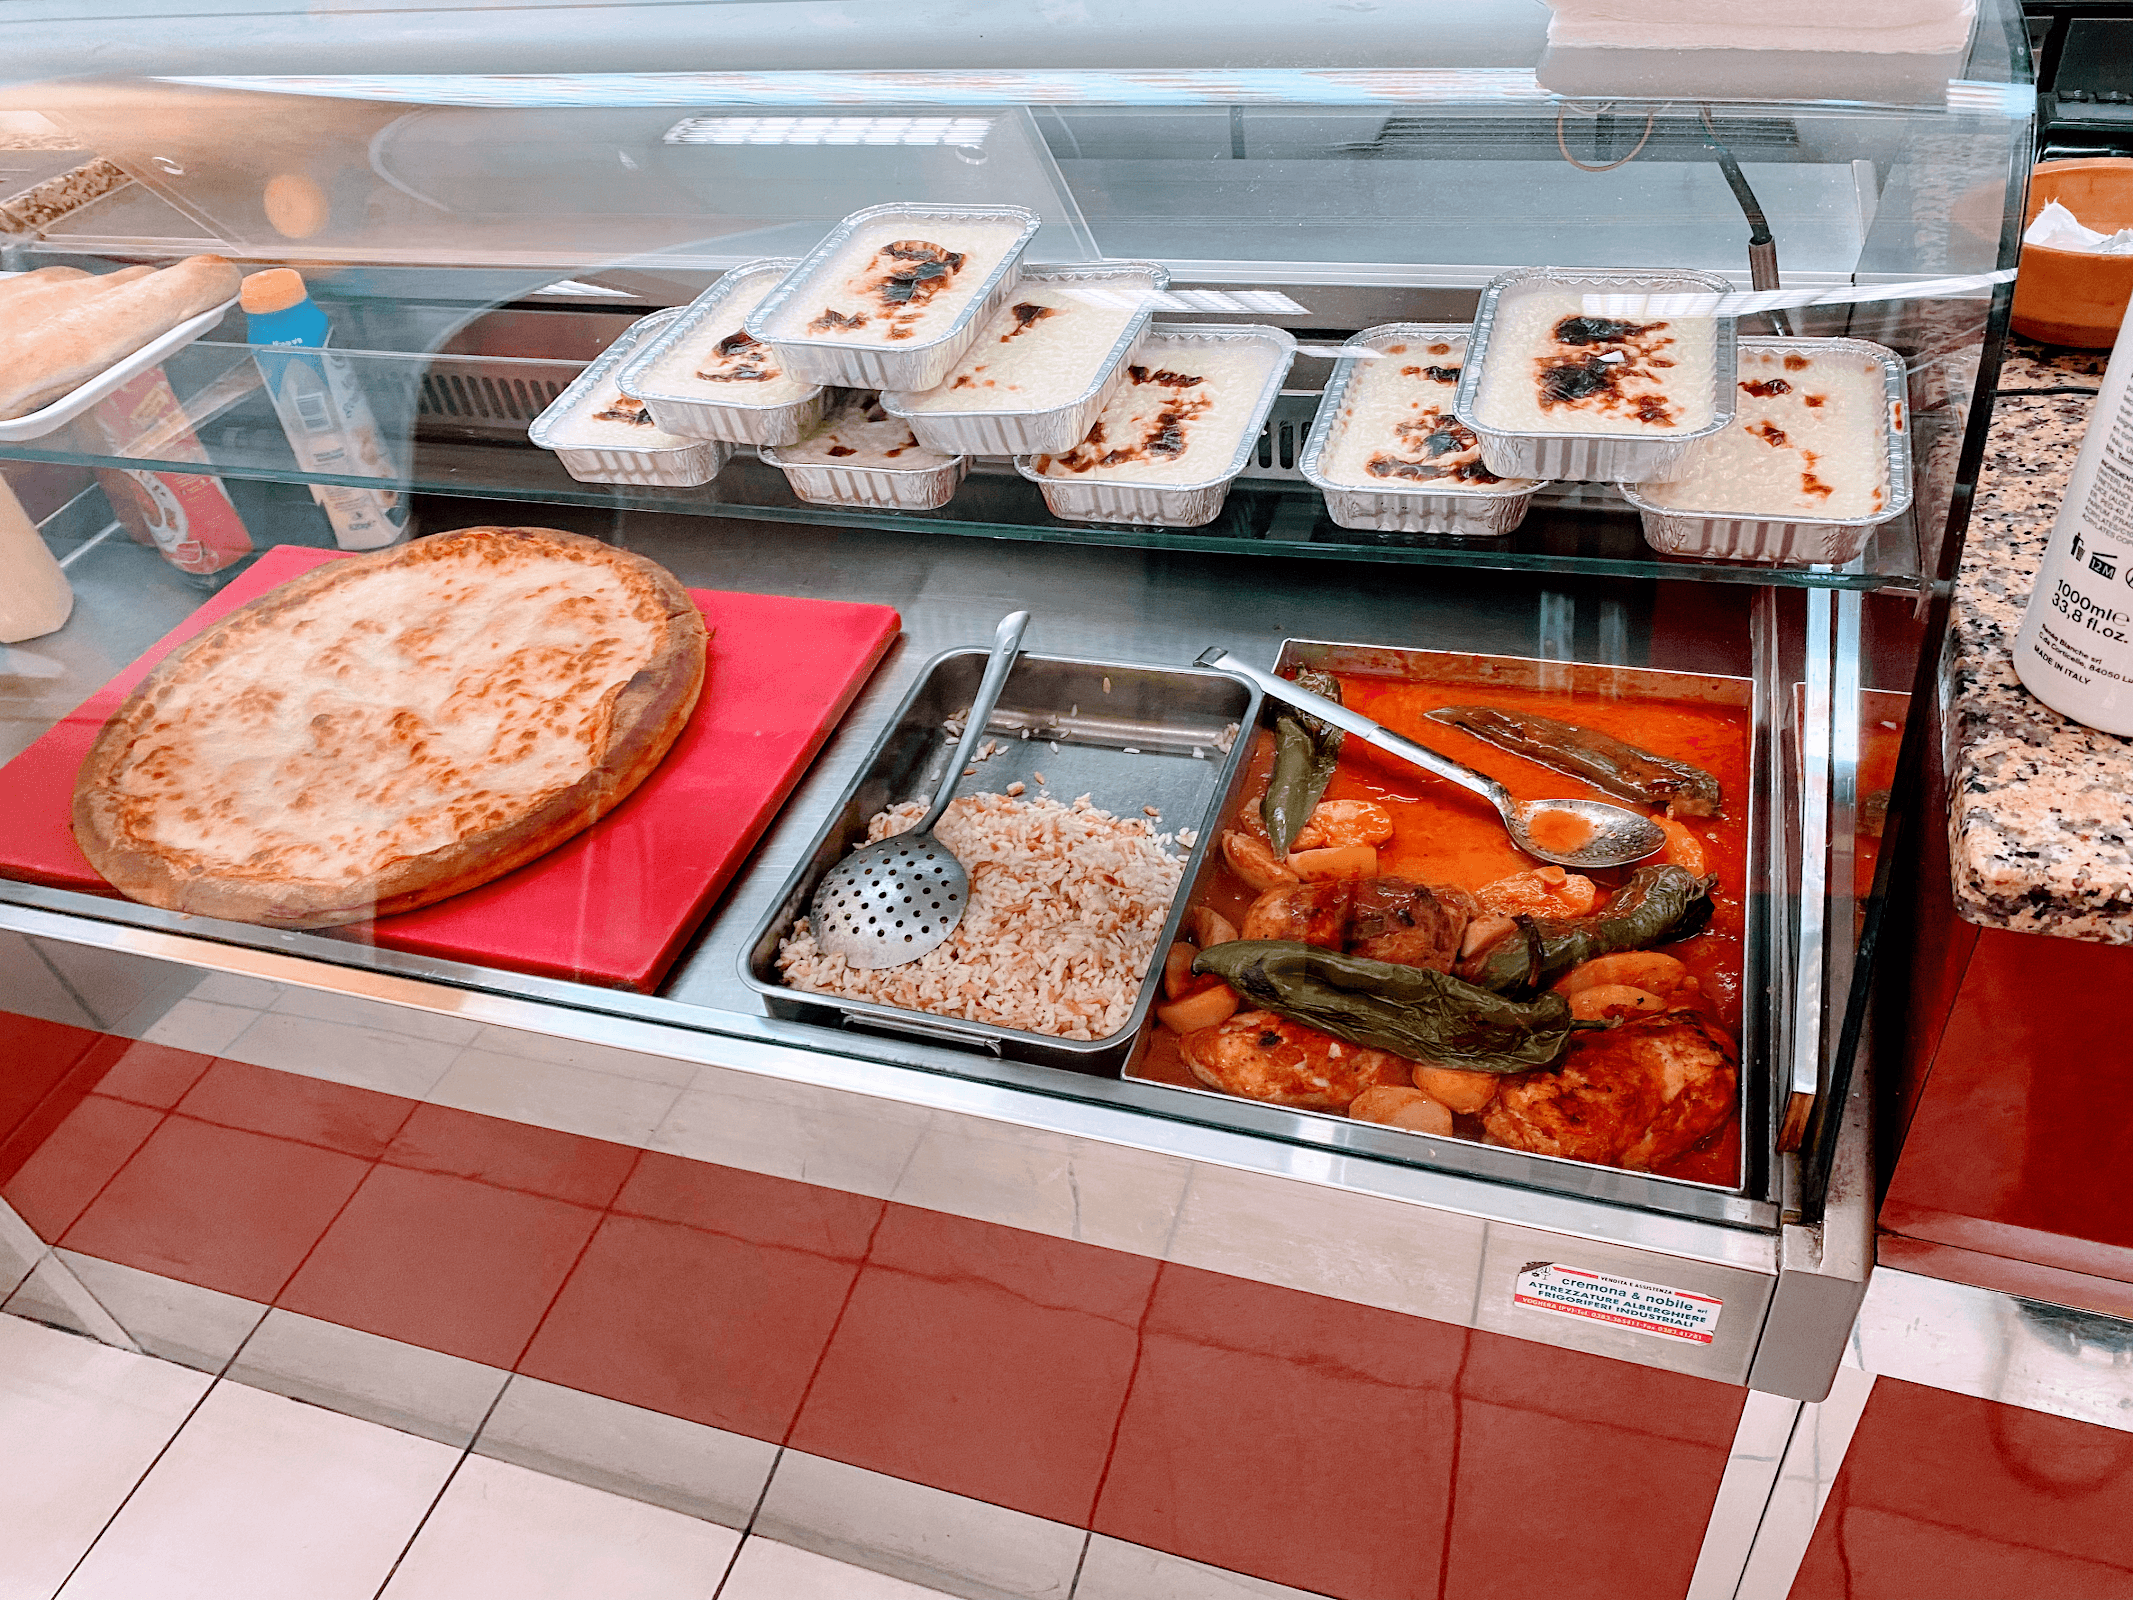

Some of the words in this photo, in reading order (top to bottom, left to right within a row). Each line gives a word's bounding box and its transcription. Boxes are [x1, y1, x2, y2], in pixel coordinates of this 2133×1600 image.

[2052, 592, 2083, 623] 33,8
[2034, 644, 2053, 666] MADE
[2054, 661, 2064, 672] IN
[2065, 668, 2092, 685] ITALY
[2089, 664, 2121, 680] 84050
[1561, 1278, 1627, 1298] cremona
[1631, 1292, 1641, 1301] &
[1645, 1295, 1694, 1311] nobile
[1601, 1276, 1628, 1286] VENDITA
[1635, 1283, 1673, 1295] ASSISTENZA
[1522, 1297, 1557, 1309] VOGHERA
[1528, 1281, 1620, 1305] ATTREZZATURE
[1623, 1301, 1707, 1323] ALBERGHIERE
[1538, 1290, 1612, 1311] FRIGORIFERI
[1616, 1307, 1694, 1328] INDUSTRIALI
